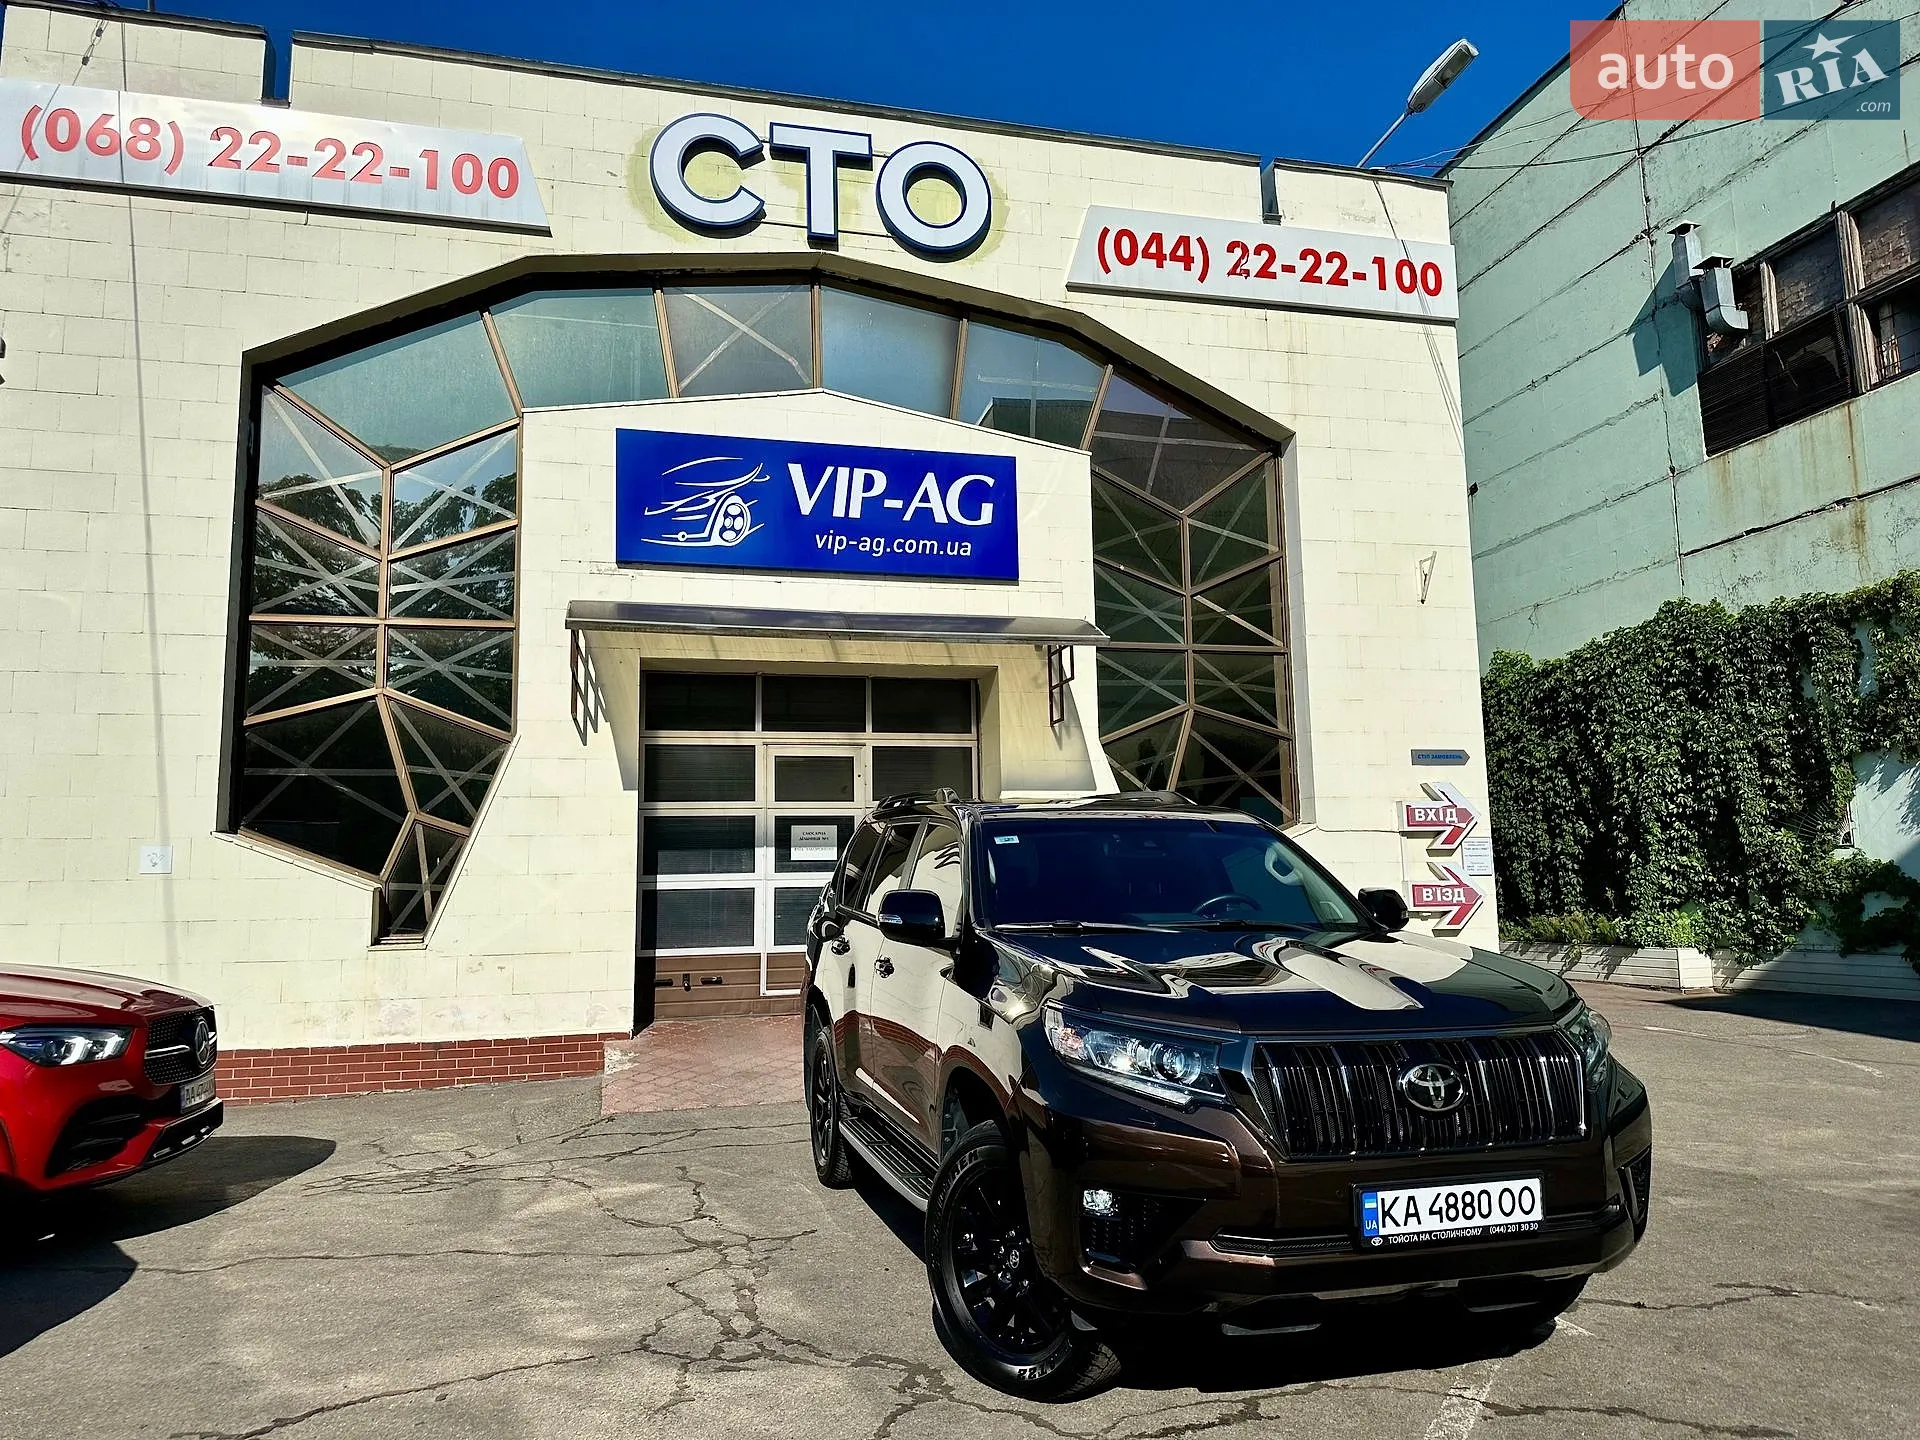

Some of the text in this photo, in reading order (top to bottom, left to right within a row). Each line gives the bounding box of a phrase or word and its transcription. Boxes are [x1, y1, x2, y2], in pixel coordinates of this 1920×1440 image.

[21, 103, 520, 200] (068) 22-22-100
[649, 113, 993, 258] СТО
[1096, 225, 1443, 298] (044) 22-22-100
[787, 461, 995, 527] VIP-AG
[814, 530, 972, 558] vip-ag.com.ua
[1414, 808, 1458, 824] ВХІД
[1365, 1220, 1378, 1231] UA
[1380, 1195, 1422, 1229] KA
[1428, 1189, 1492, 1224] 4880
[1388, 1222, 1539, 1245] ТОЙОТА НА СТОЛИЧНОМУ (044) 201 30 30
